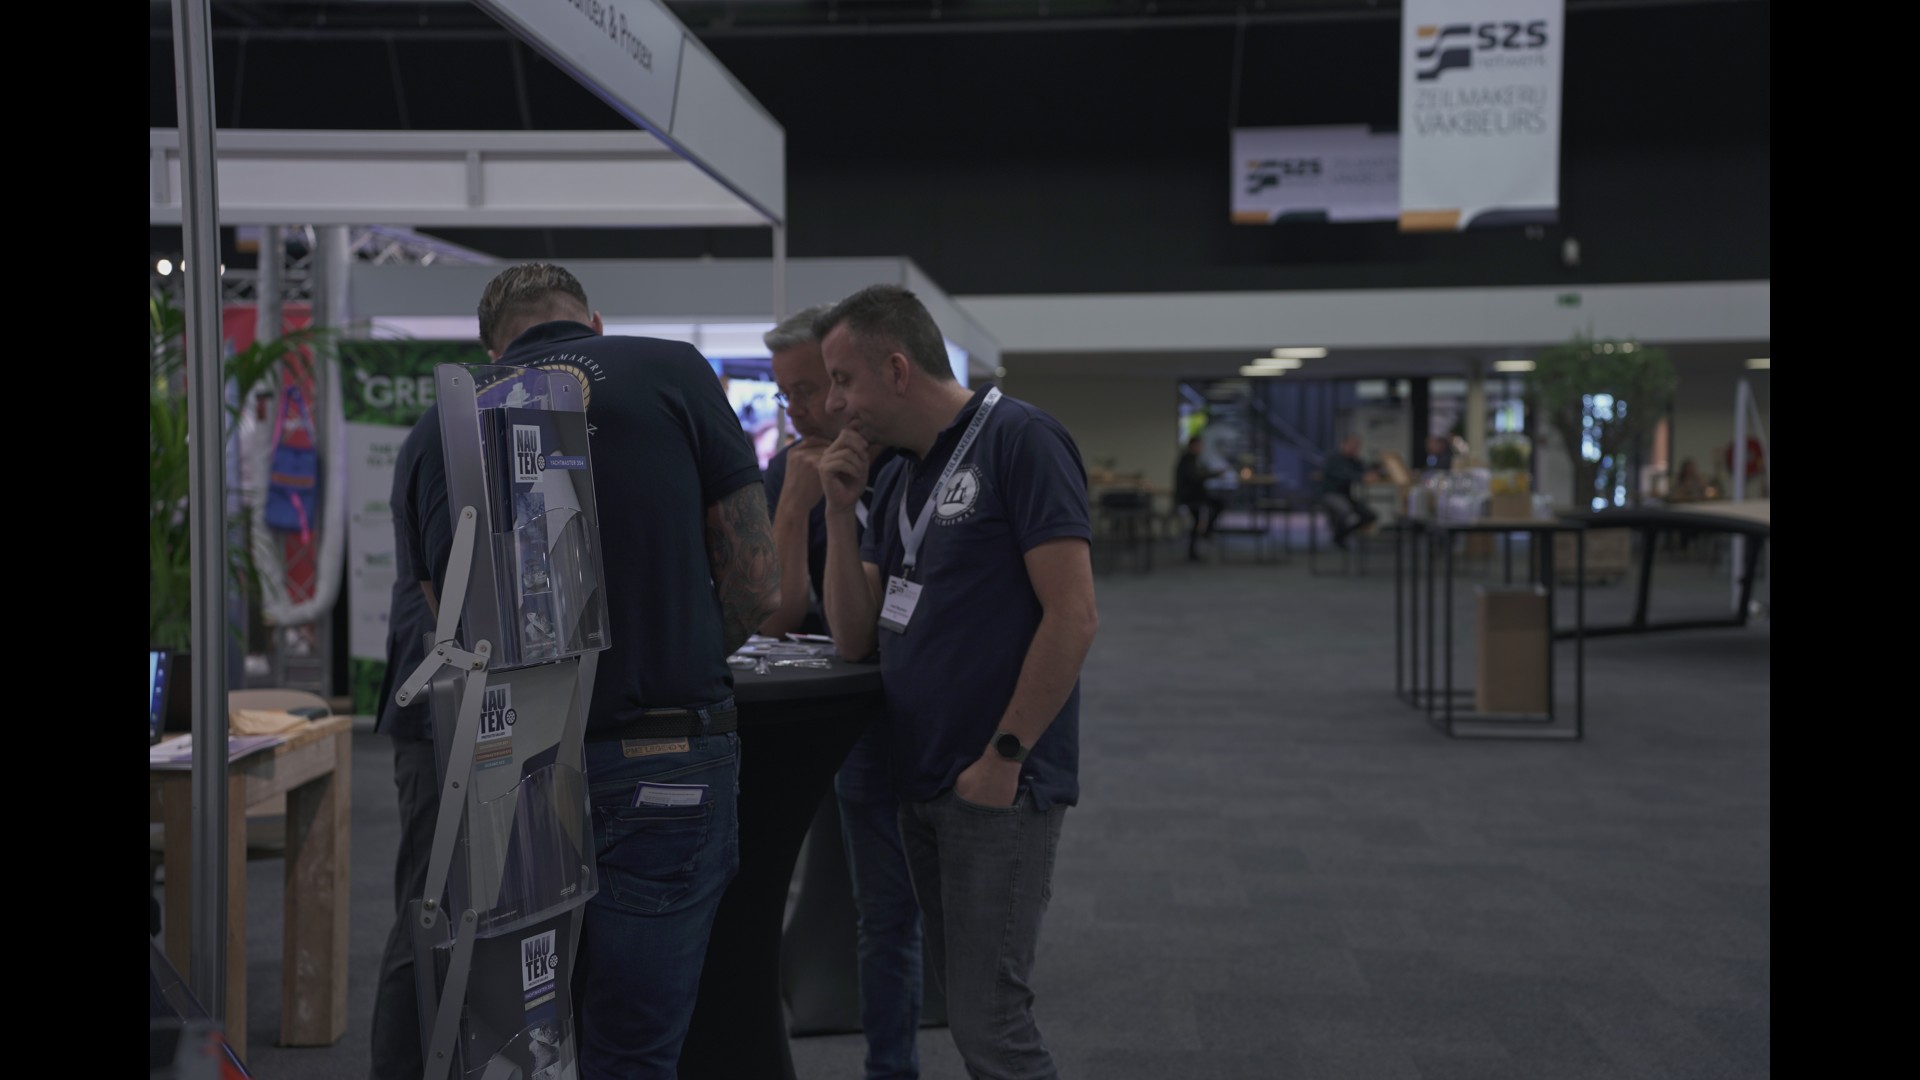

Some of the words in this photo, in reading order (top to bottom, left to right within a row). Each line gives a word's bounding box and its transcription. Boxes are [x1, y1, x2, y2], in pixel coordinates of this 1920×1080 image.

[1477, 20, 1549, 50] SZS
[1413, 110, 1547, 138] VAKBEURS
[516, 429, 538, 452] NAU
[517, 452, 538, 475] TEX
[480, 709, 505, 734] TEX
[525, 935, 550, 962] NAU
[526, 956, 549, 981] TEX
